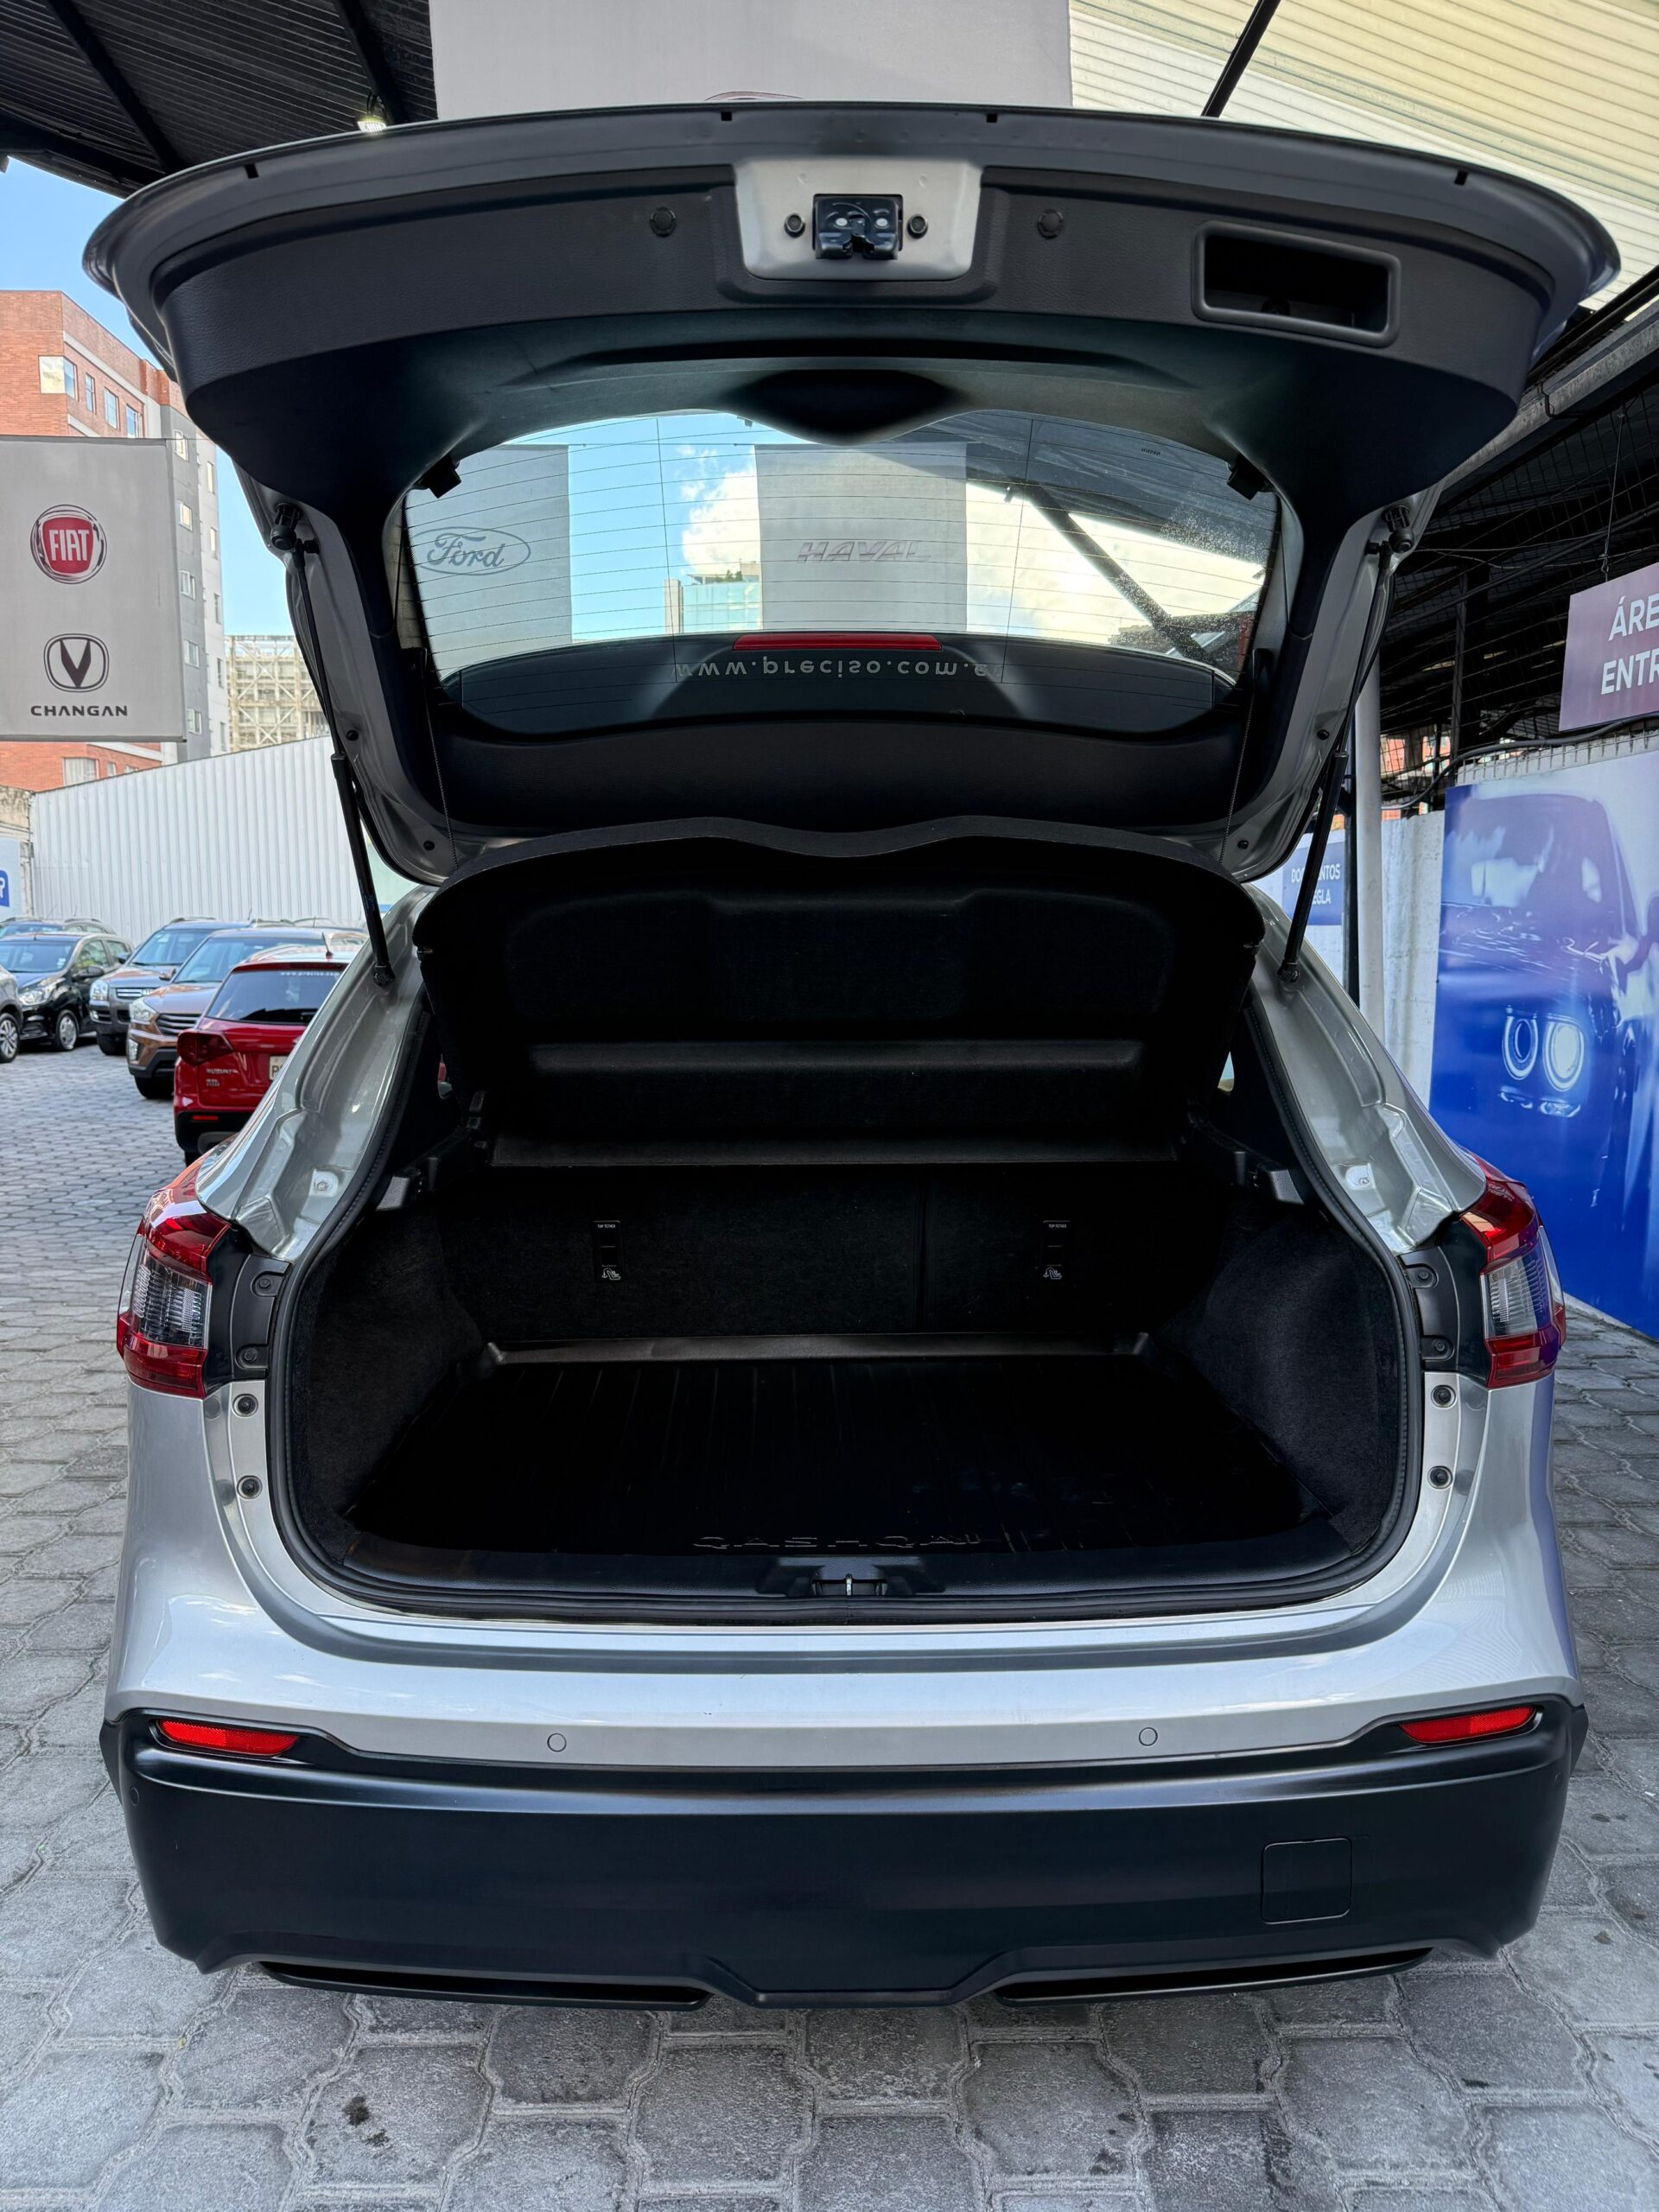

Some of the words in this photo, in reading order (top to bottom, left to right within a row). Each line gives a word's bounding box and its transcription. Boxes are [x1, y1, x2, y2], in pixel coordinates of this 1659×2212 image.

[48, 529, 89, 562] FIAT
[427, 532, 505, 568] Ford
[798, 541, 931, 563] HAVAL
[1608, 593, 1659, 641] ÁRE
[30, 705, 128, 716] CHANGAN
